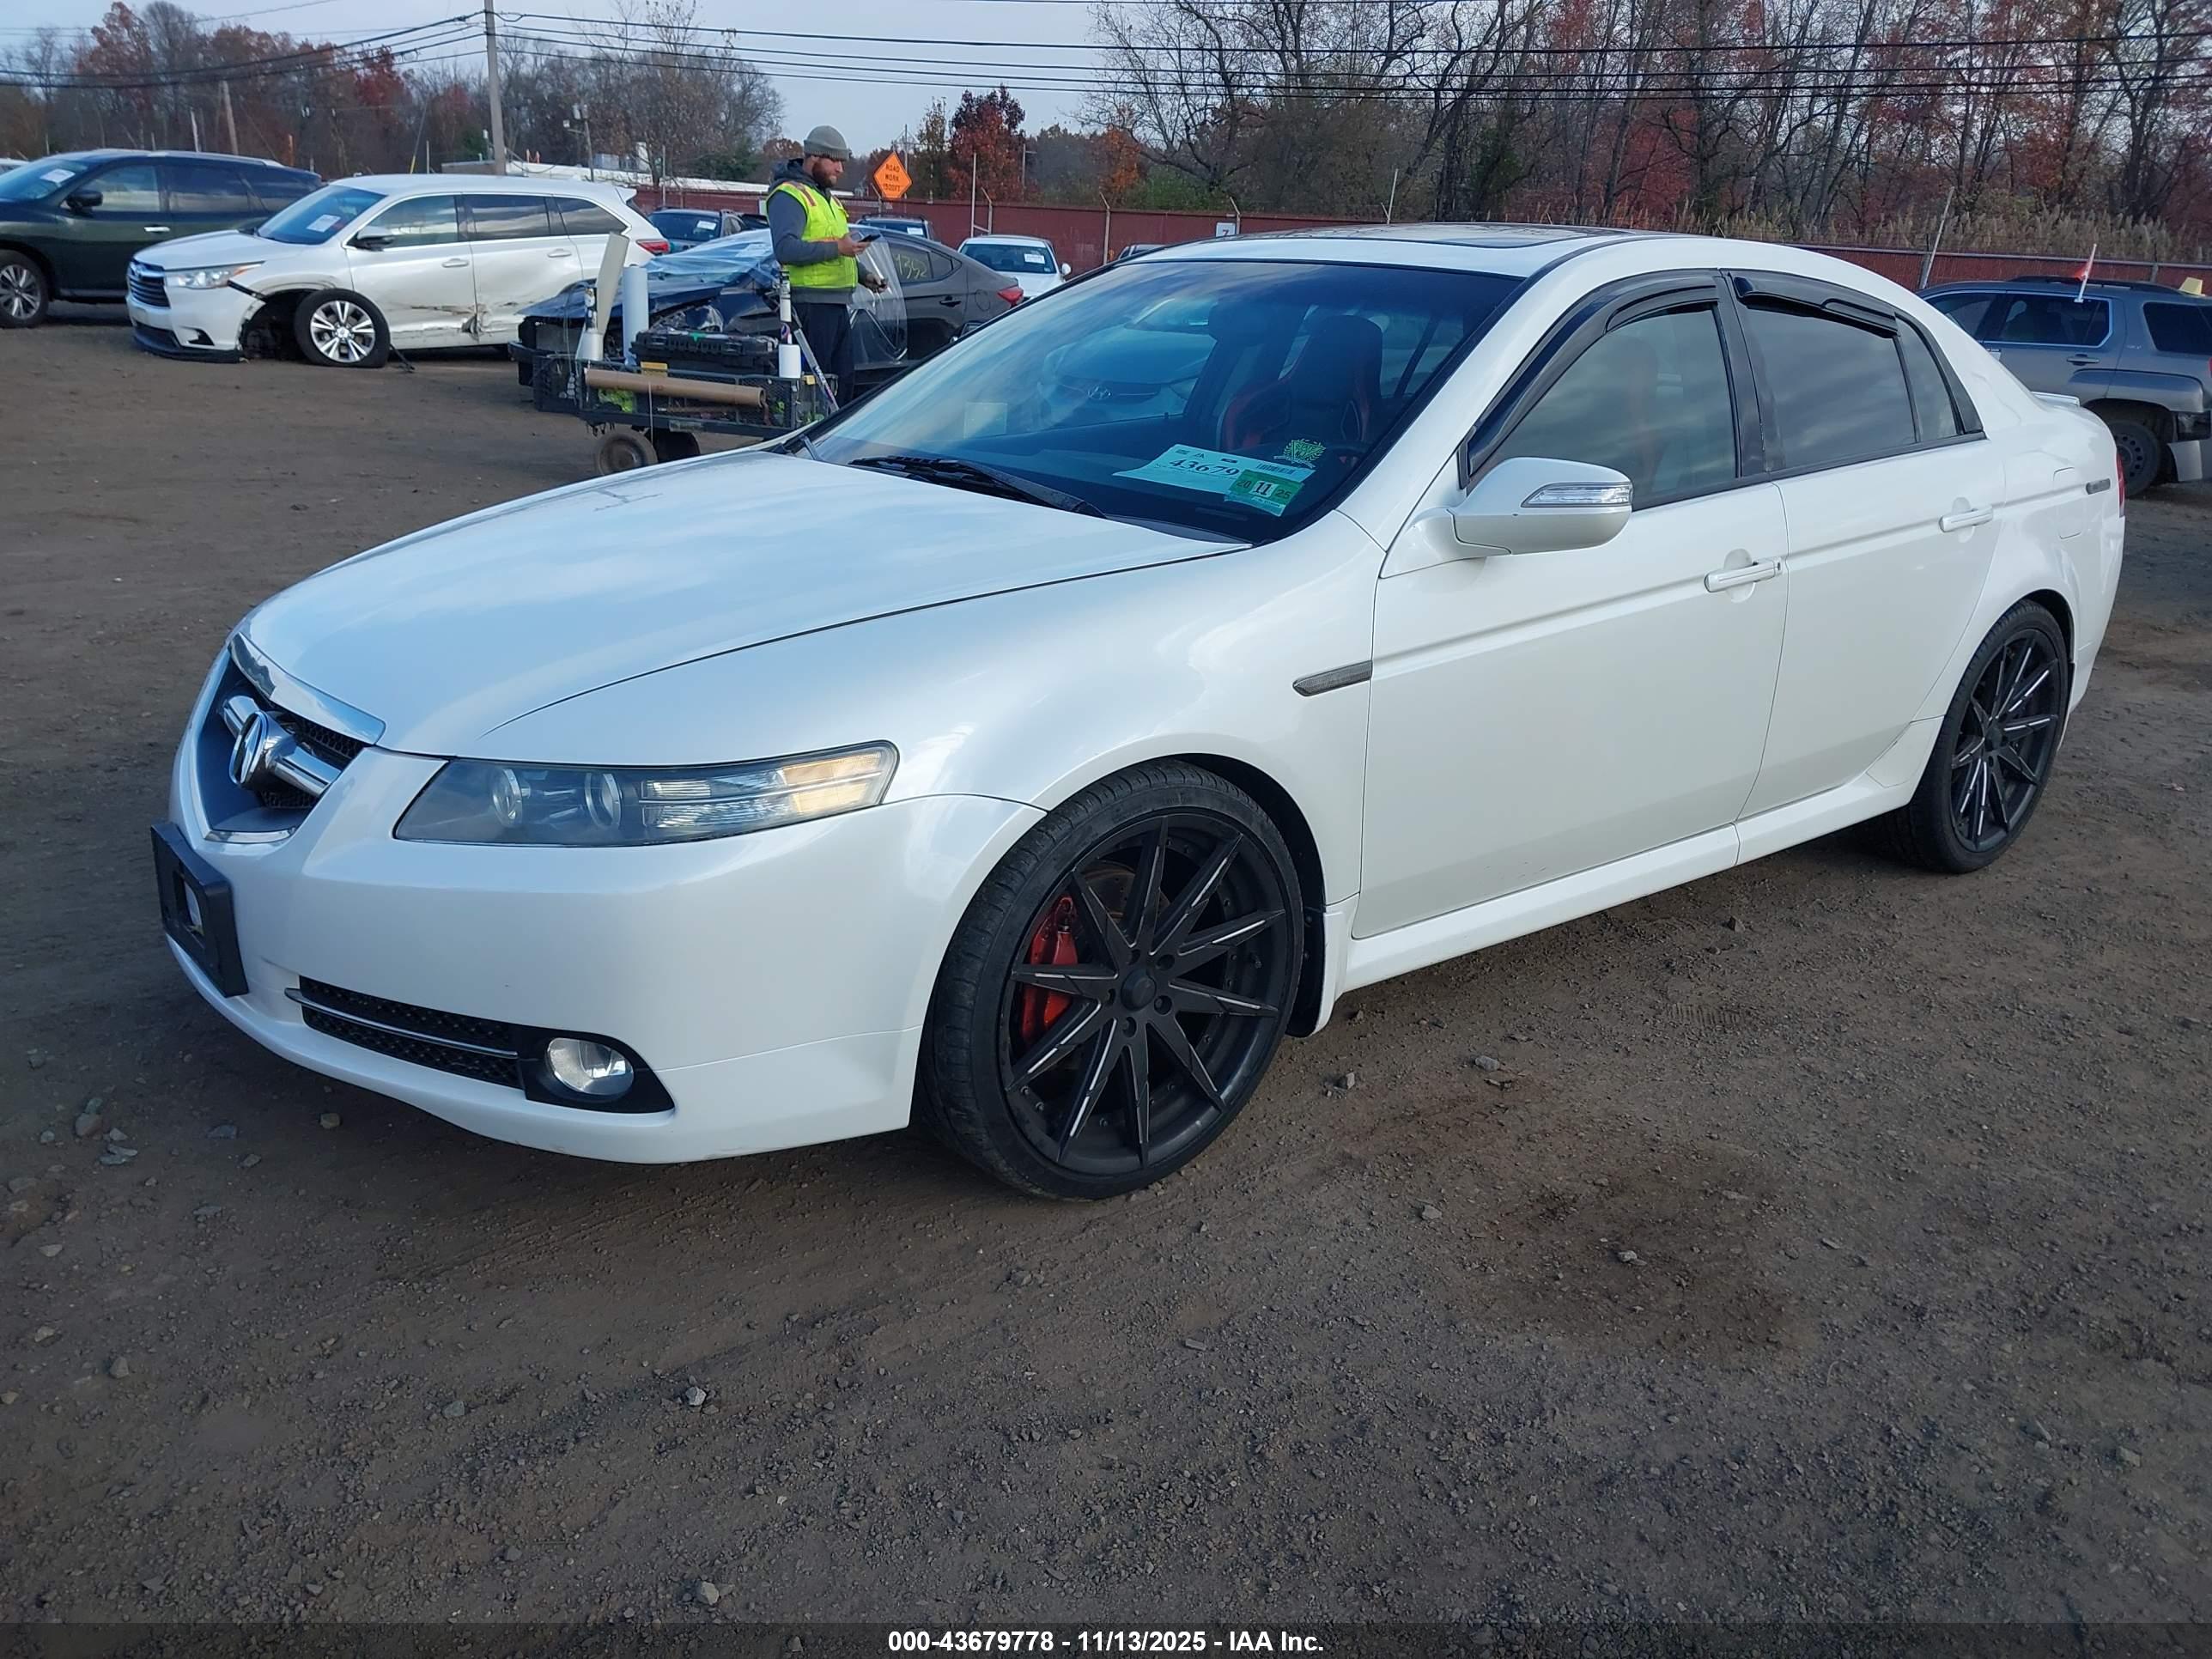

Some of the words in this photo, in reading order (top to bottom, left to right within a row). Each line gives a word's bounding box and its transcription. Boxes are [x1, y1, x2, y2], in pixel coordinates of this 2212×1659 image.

[885, 163, 900, 172] ROAD
[1237, 480, 1252, 489] 20
[1253, 482, 1272, 495] 11
[1275, 489, 1291, 499] 25
